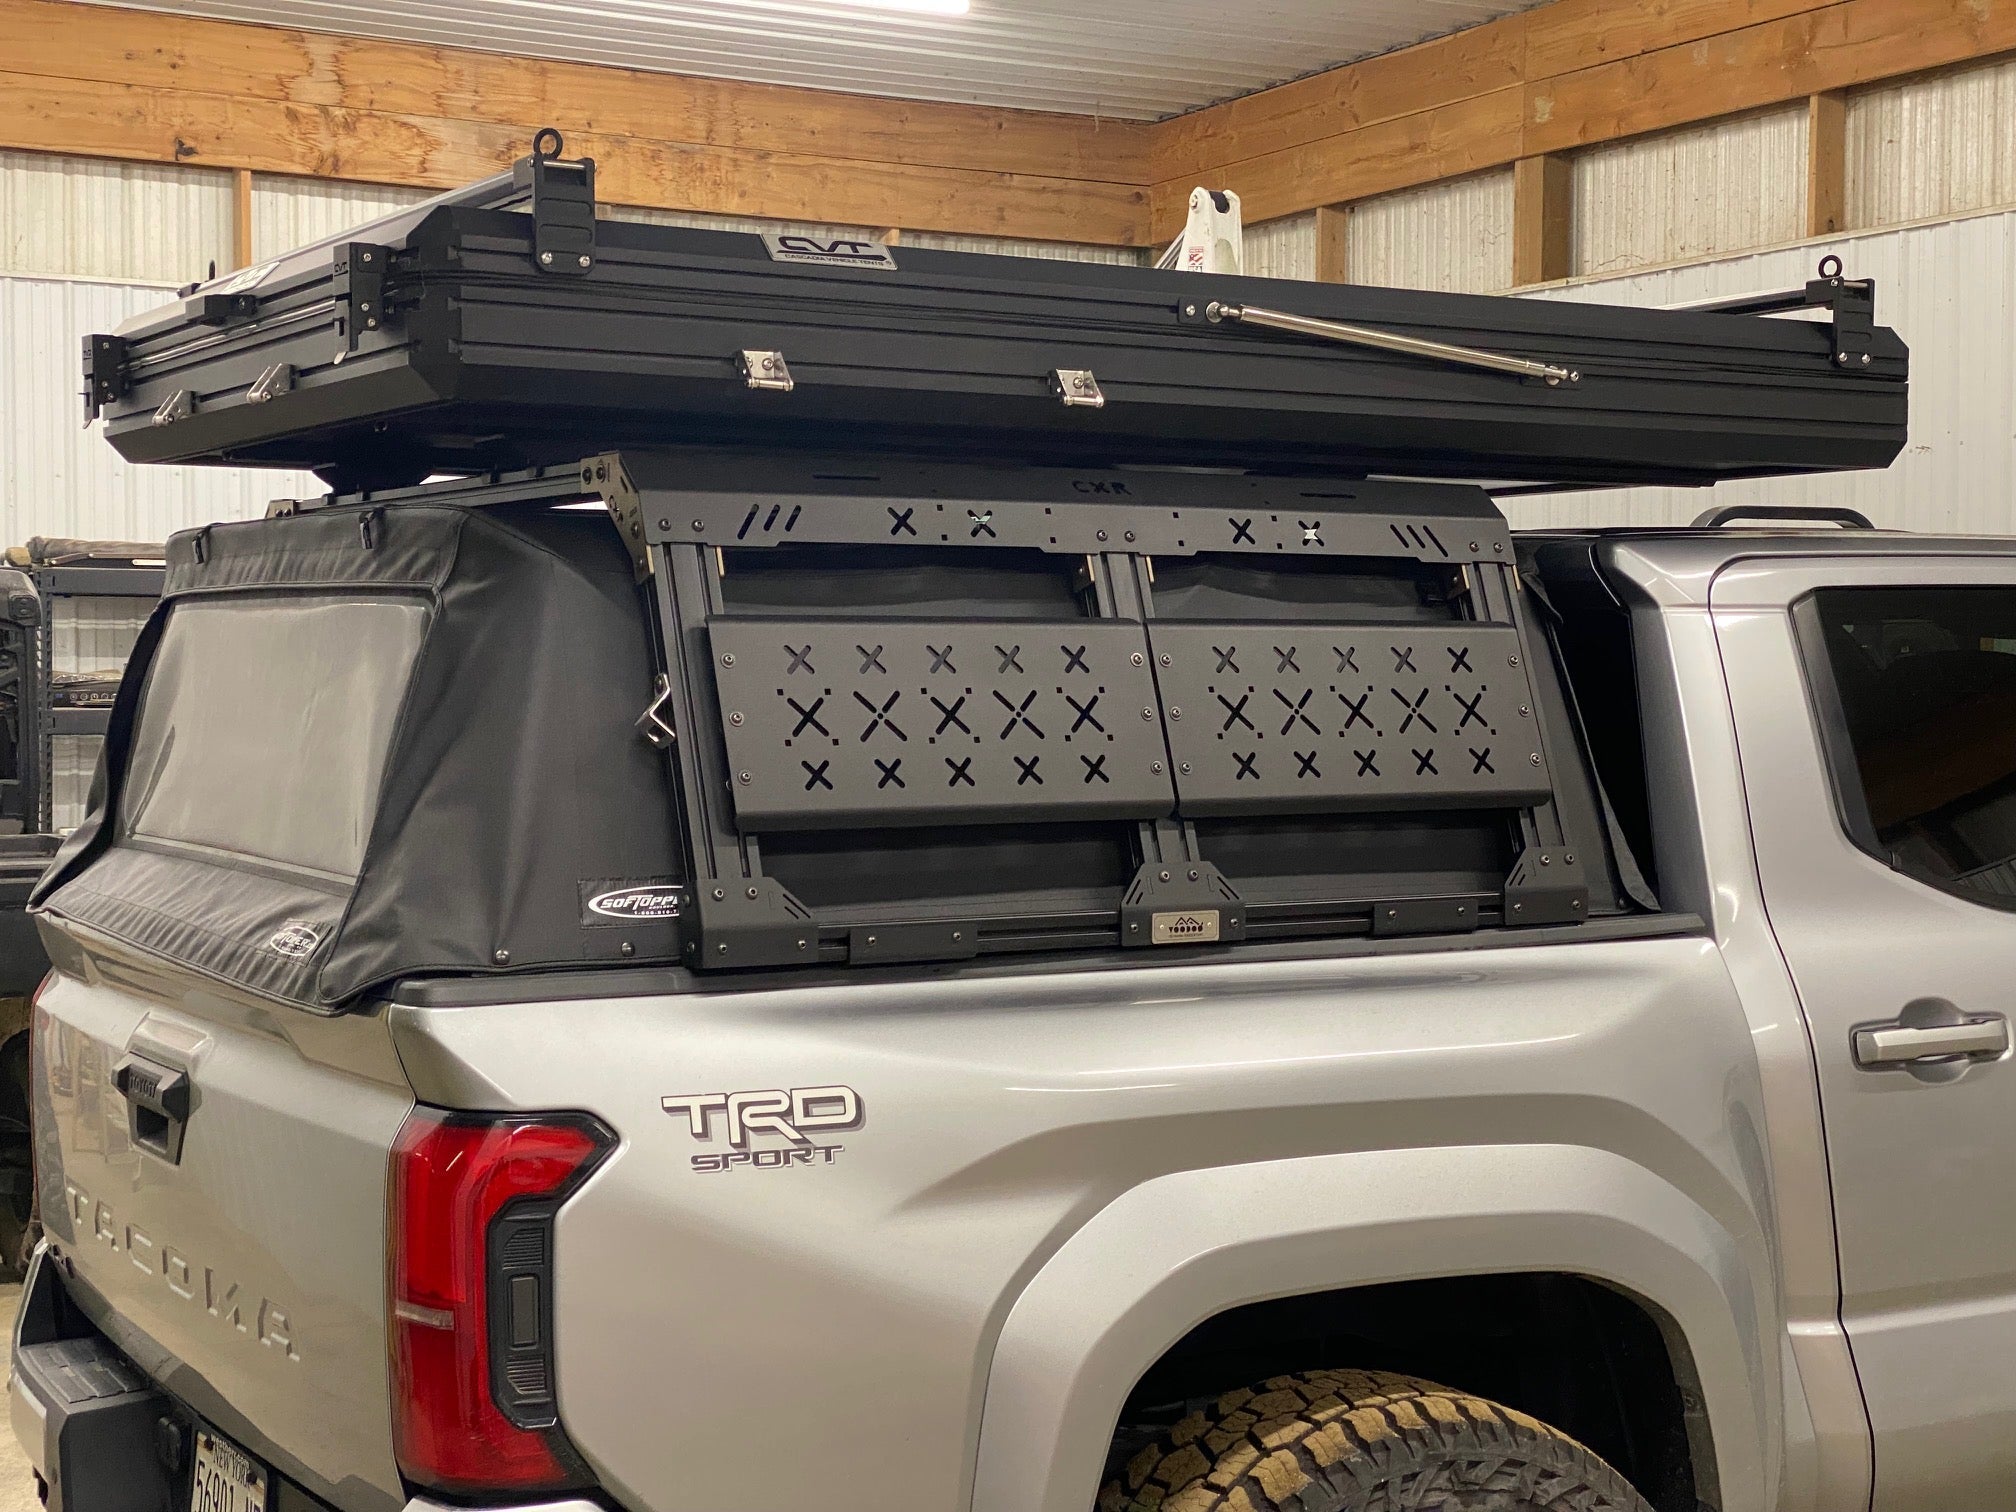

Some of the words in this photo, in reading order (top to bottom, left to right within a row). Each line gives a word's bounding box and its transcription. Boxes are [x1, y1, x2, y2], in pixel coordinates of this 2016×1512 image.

[778, 236, 873, 254] CVT
[1071, 481, 1132, 495] CXR
[661, 1085, 864, 1149] TRD
[690, 1145, 846, 1174] SPORT
[66, 1176, 301, 1363] TACOMA
